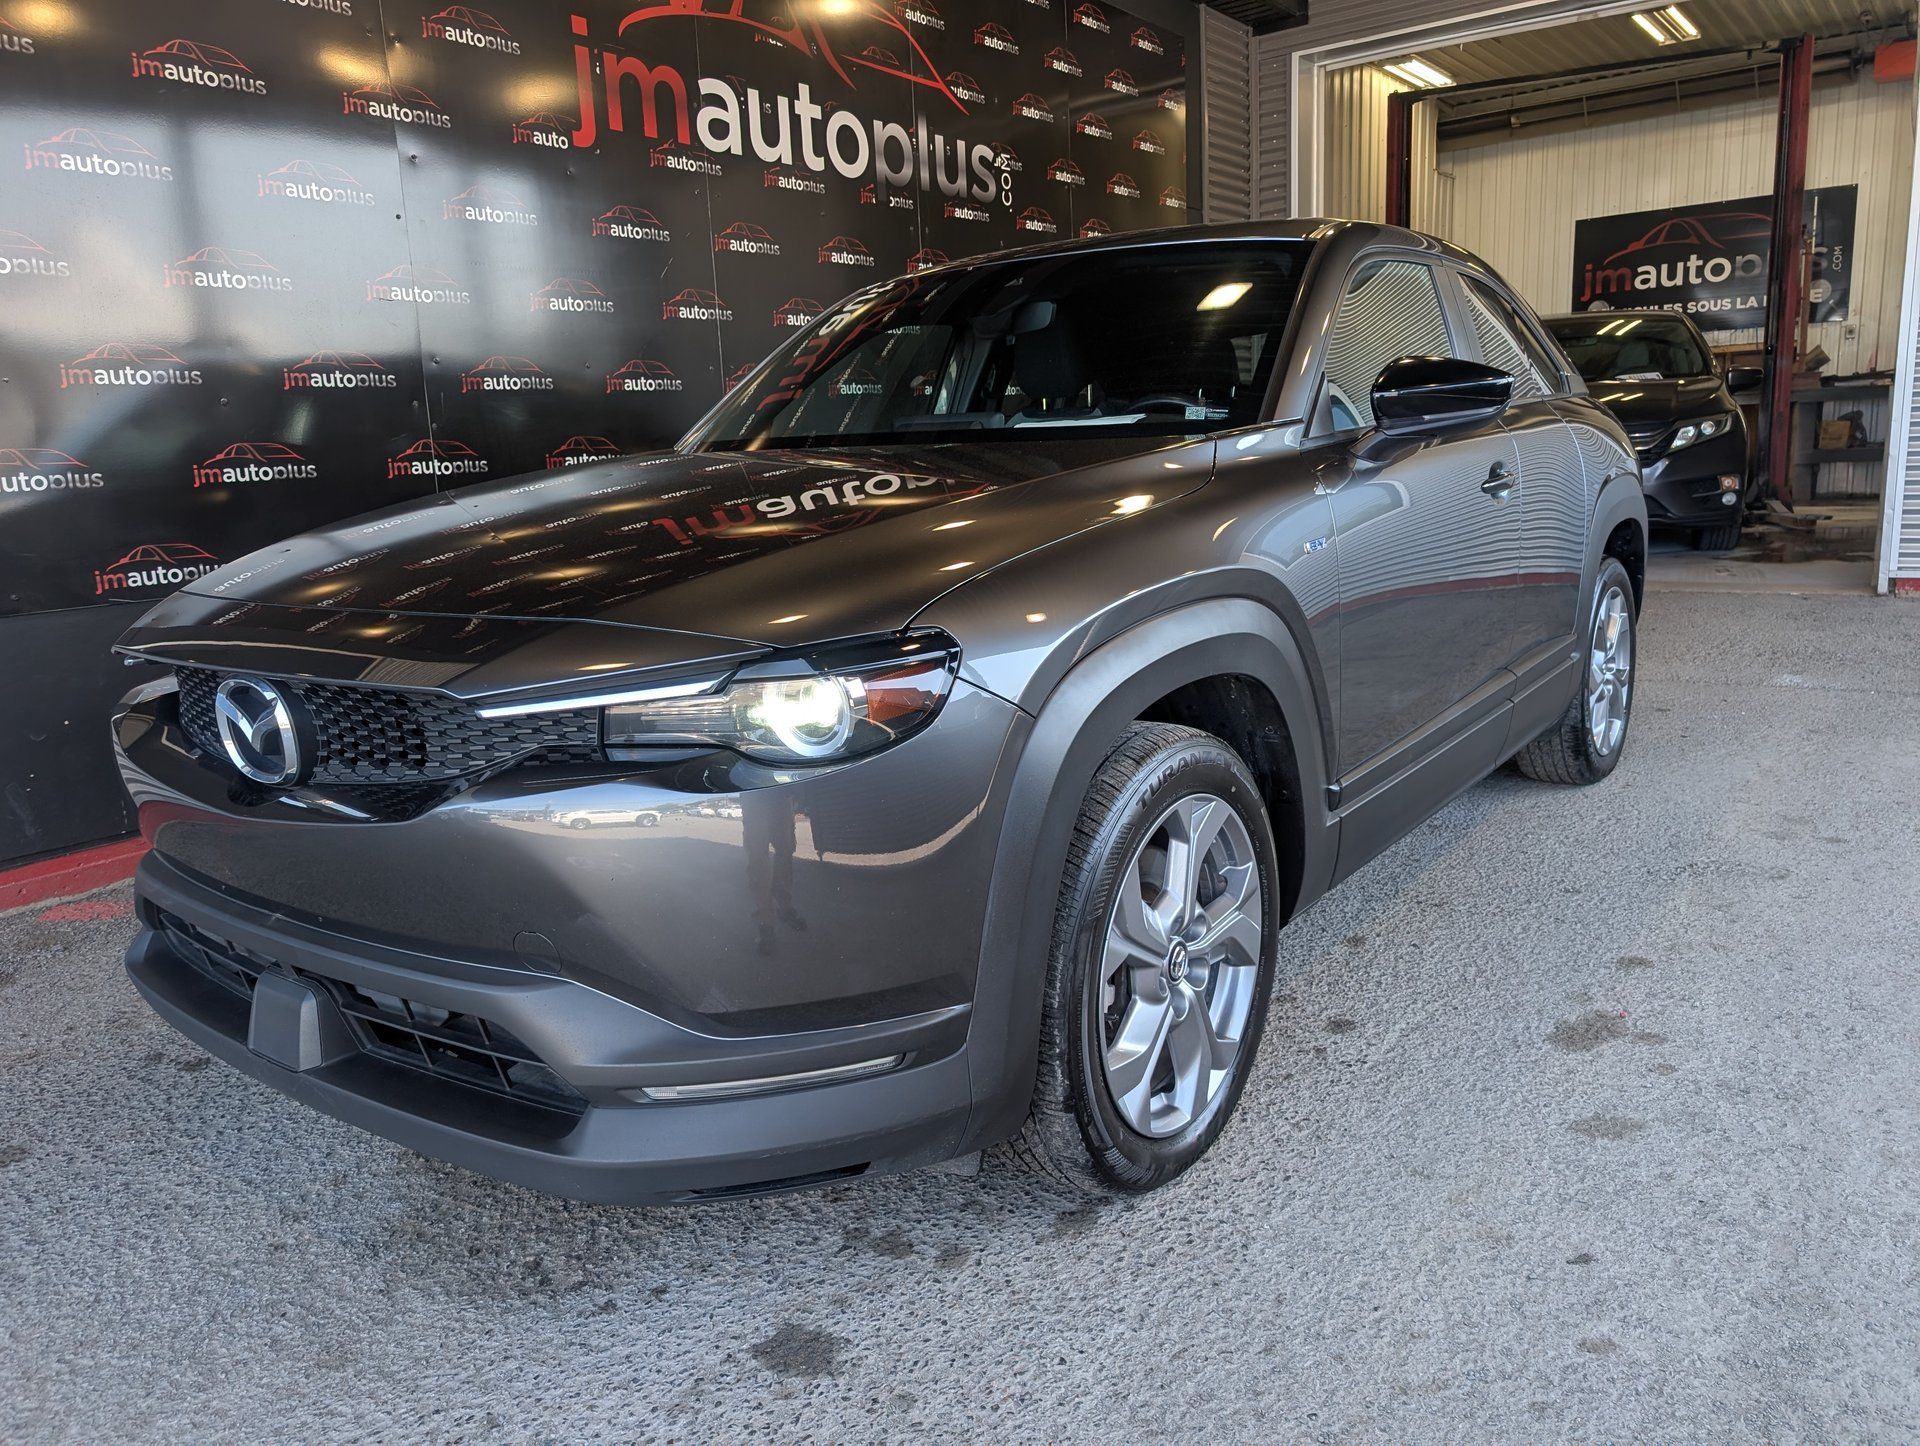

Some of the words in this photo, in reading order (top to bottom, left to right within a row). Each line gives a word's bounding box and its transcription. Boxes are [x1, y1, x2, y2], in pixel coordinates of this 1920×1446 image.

[421, 17, 520, 56] jmautoplus
[131, 52, 267, 96] jmautoplus
[343, 92, 451, 128] jmautoplus
[571, 14, 997, 203] jmautoplus
[512, 123, 570, 149] jmauto
[24, 143, 173, 182] jmautoplus
[650, 149, 722, 176] jmautoplus
[257, 174, 375, 206] jmautoplus
[442, 199, 538, 227] jmautoplus
[592, 218, 670, 242] jmautoplus
[714, 234, 780, 256] jmautoplus
[163, 264, 293, 291] jmautoplus
[530, 293, 614, 313] jmautoplus
[662, 301, 733, 321] jmautoplus
[1686, 299, 1732, 314] SOUS
[1736, 296, 1759, 309] LA
[60, 363, 203, 389] jmautoplus
[283, 368, 397, 390] jmautoplus
[461, 372, 554, 393] jmautoplus
[606, 375, 683, 393] jmautoplus
[0, 471, 104, 492] utoplus
[193, 462, 317, 488] jmautoplus
[387, 458, 489, 479] jmautoplus
